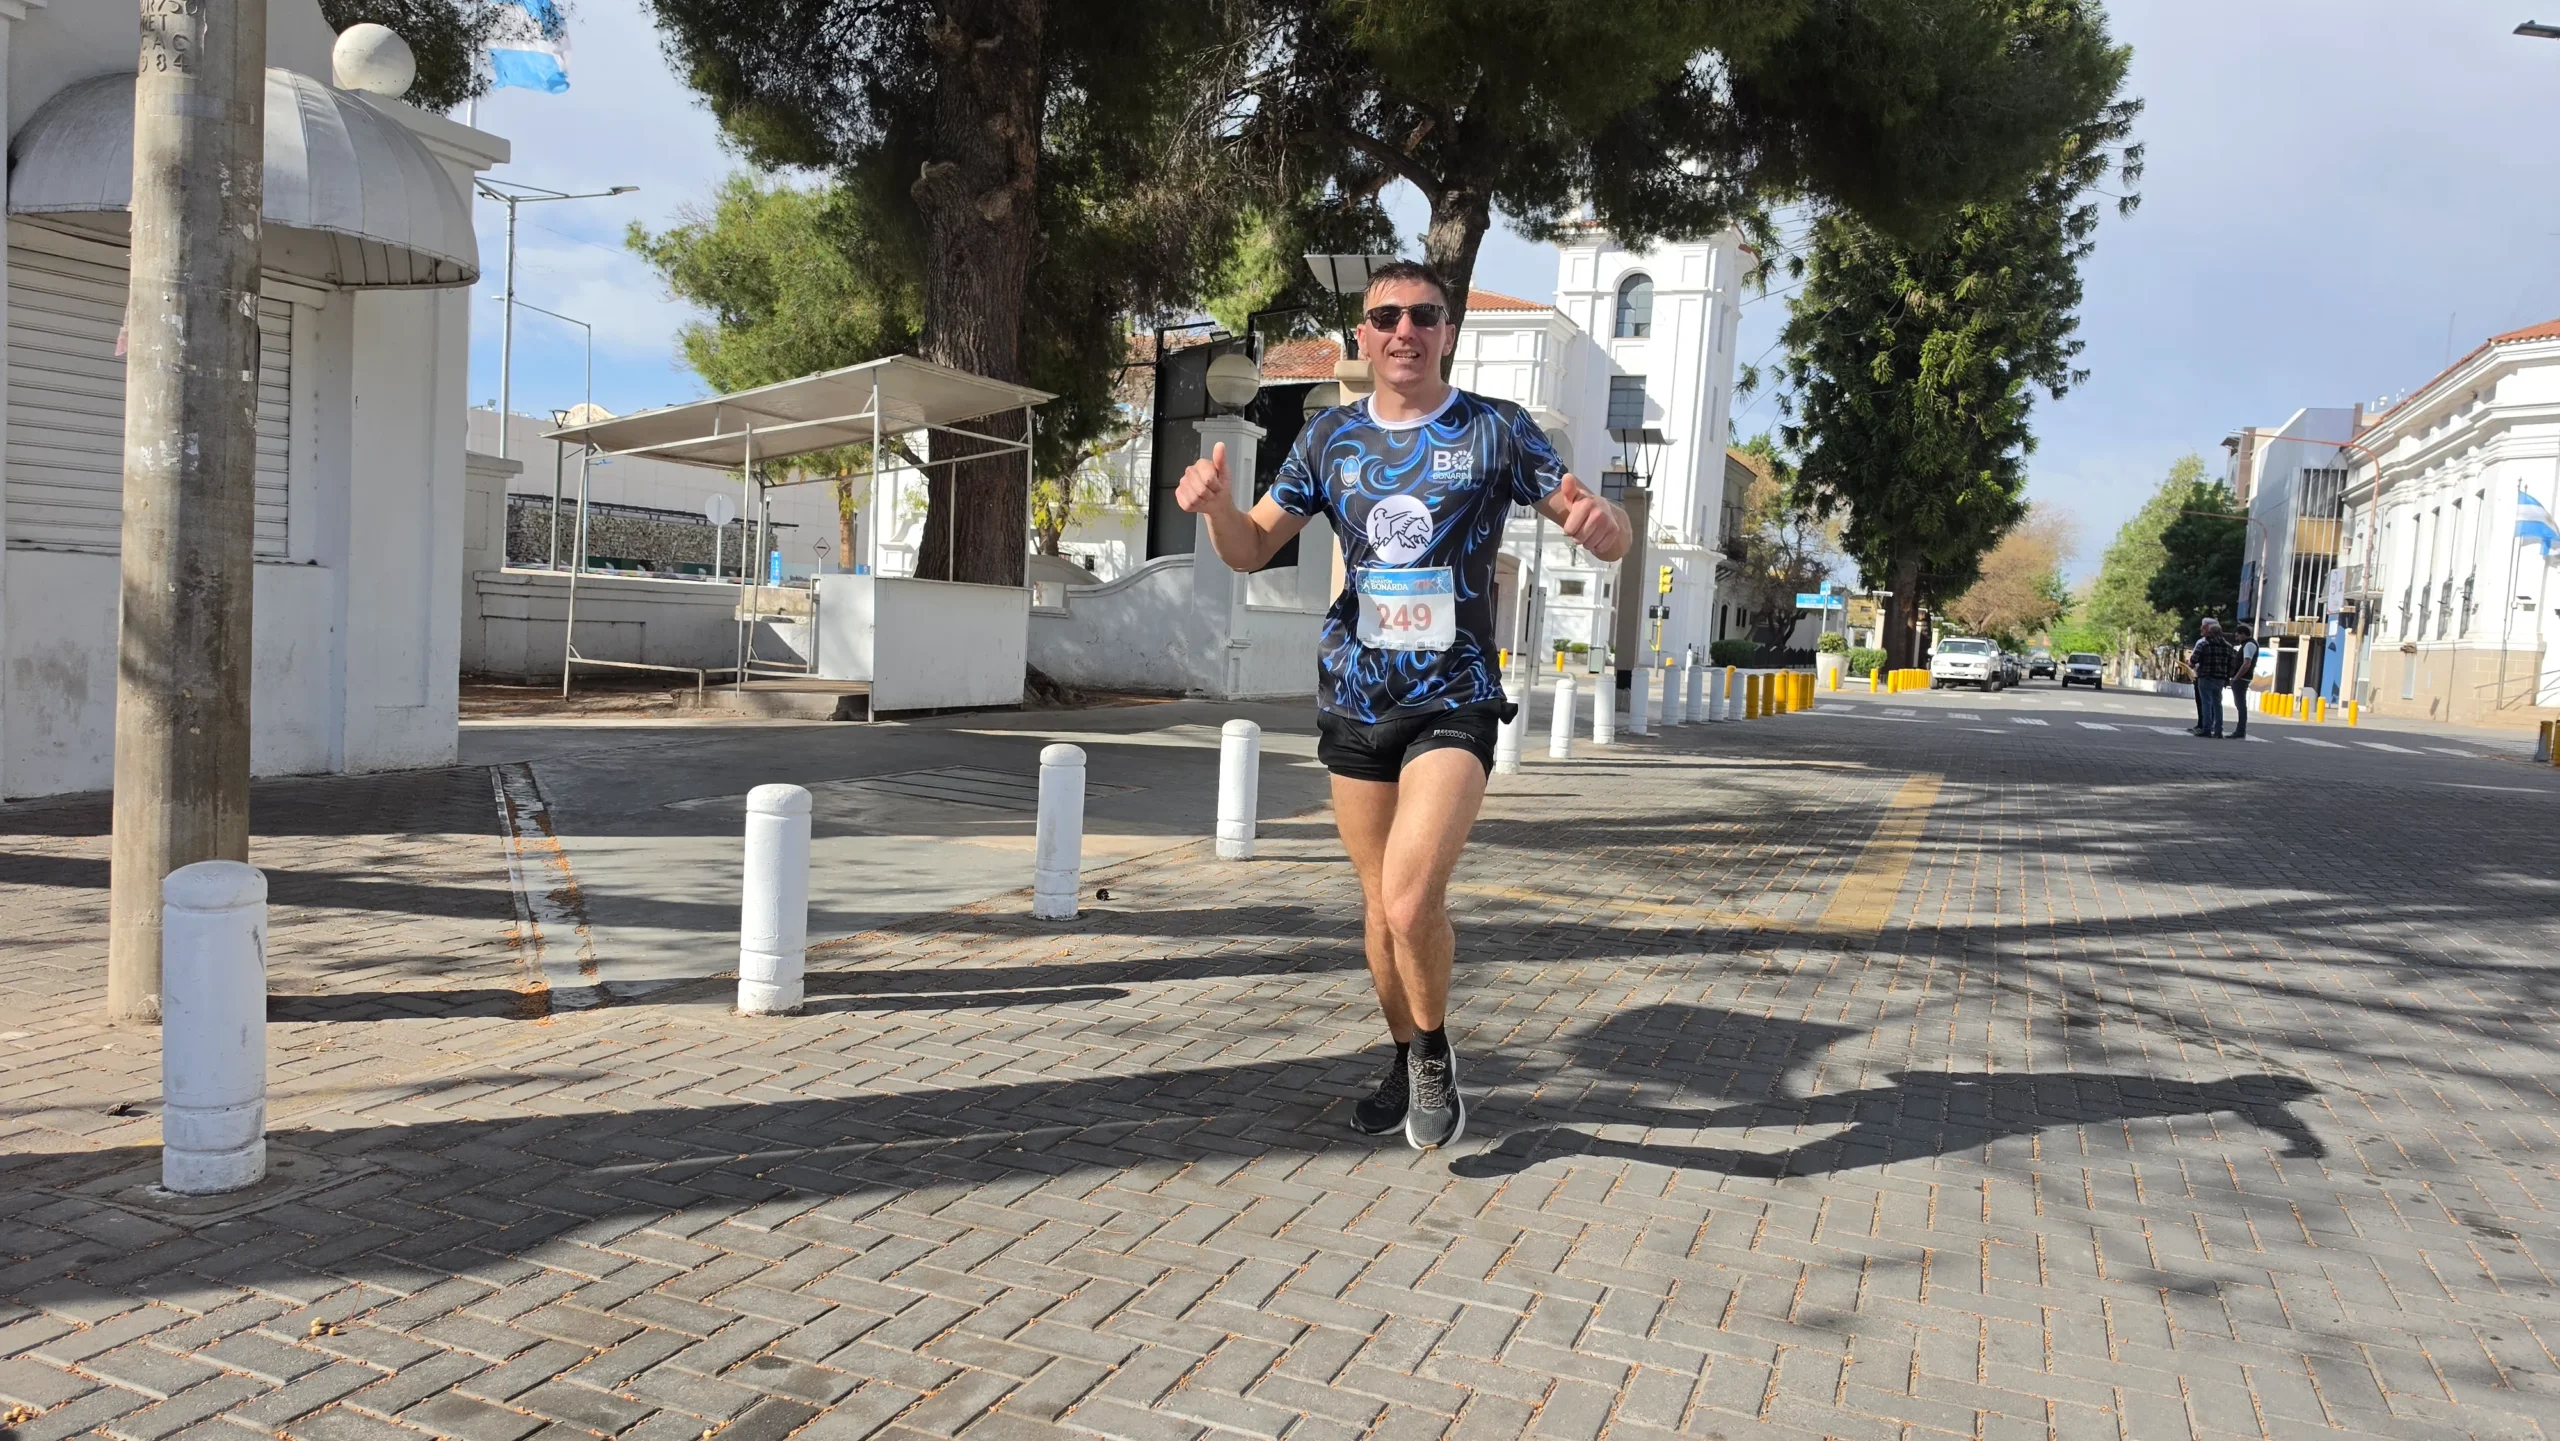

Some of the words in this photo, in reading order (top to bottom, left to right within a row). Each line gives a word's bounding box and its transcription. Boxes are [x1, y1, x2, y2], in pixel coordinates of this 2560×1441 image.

[1432, 472, 1472, 480] BONARDA
[1371, 583, 1409, 591] BONARDA
[1376, 602, 1432, 632] 249
